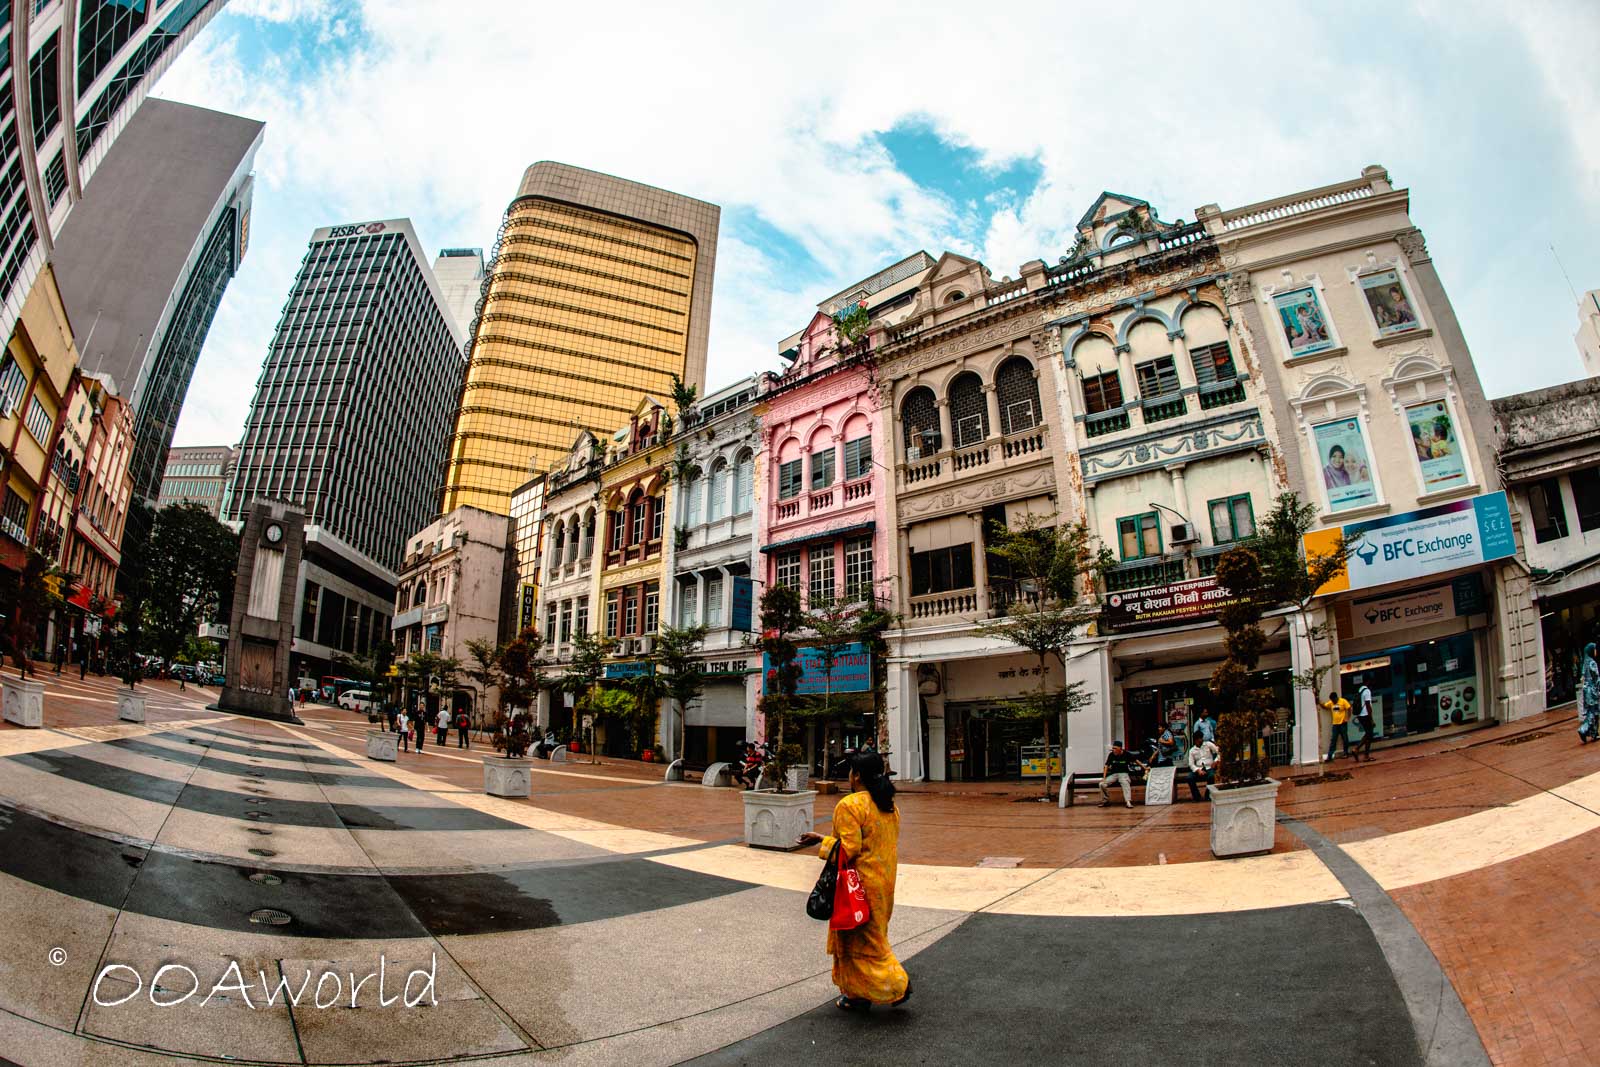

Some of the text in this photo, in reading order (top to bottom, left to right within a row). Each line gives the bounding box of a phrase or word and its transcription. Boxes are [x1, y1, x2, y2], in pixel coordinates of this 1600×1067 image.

[328, 224, 365, 238] HSBC
[1382, 538, 1415, 561] BFC
[1416, 533, 1473, 554] Exchange
[1122, 592, 1139, 600] NEW
[1140, 587, 1168, 598] NATION
[1143, 597, 1171, 609] नेशन
[1173, 590, 1199, 605] मिनी
[1152, 609, 1175, 617] PAKAIAN
[1176, 605, 1196, 614] FESYEN
[1200, 601, 1227, 610] LAIN-LIAN
[1380, 607, 1402, 622] BFC
[1404, 602, 1443, 617] Exchange
[710, 661, 729, 672] TECK
